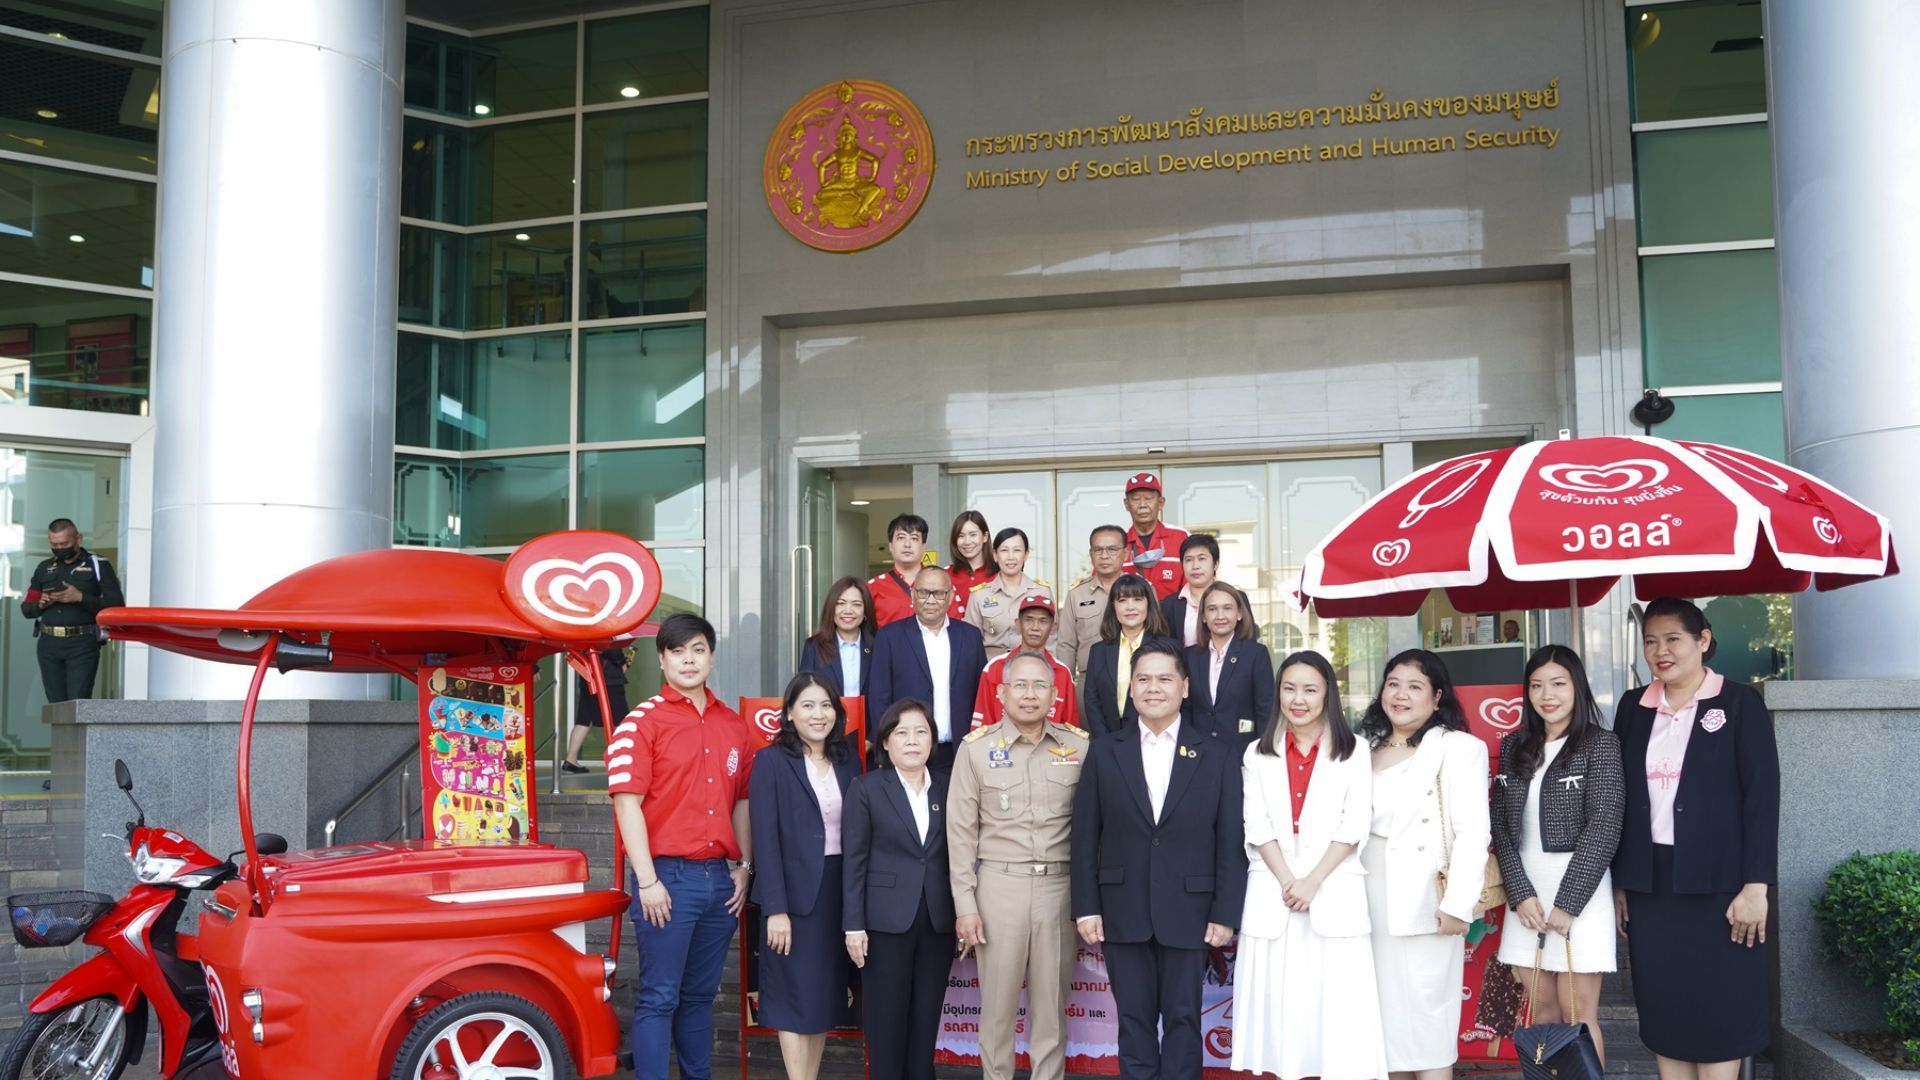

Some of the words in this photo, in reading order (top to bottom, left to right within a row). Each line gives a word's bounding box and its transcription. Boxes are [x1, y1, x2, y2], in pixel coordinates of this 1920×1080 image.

[964, 77, 1561, 158] กระทรวงการพัฒนาสังคมและความมั่นคงของมนุษย์
[965, 167, 1049, 190] Ministry
[1056, 160, 1080, 182] of
[1086, 155, 1150, 180] Social
[1158, 142, 1312, 174] Development
[1319, 138, 1363, 161] and
[1372, 134, 1456, 158] Human
[1464, 124, 1561, 150] Security
[1089, 1009, 1106, 1018] และ
